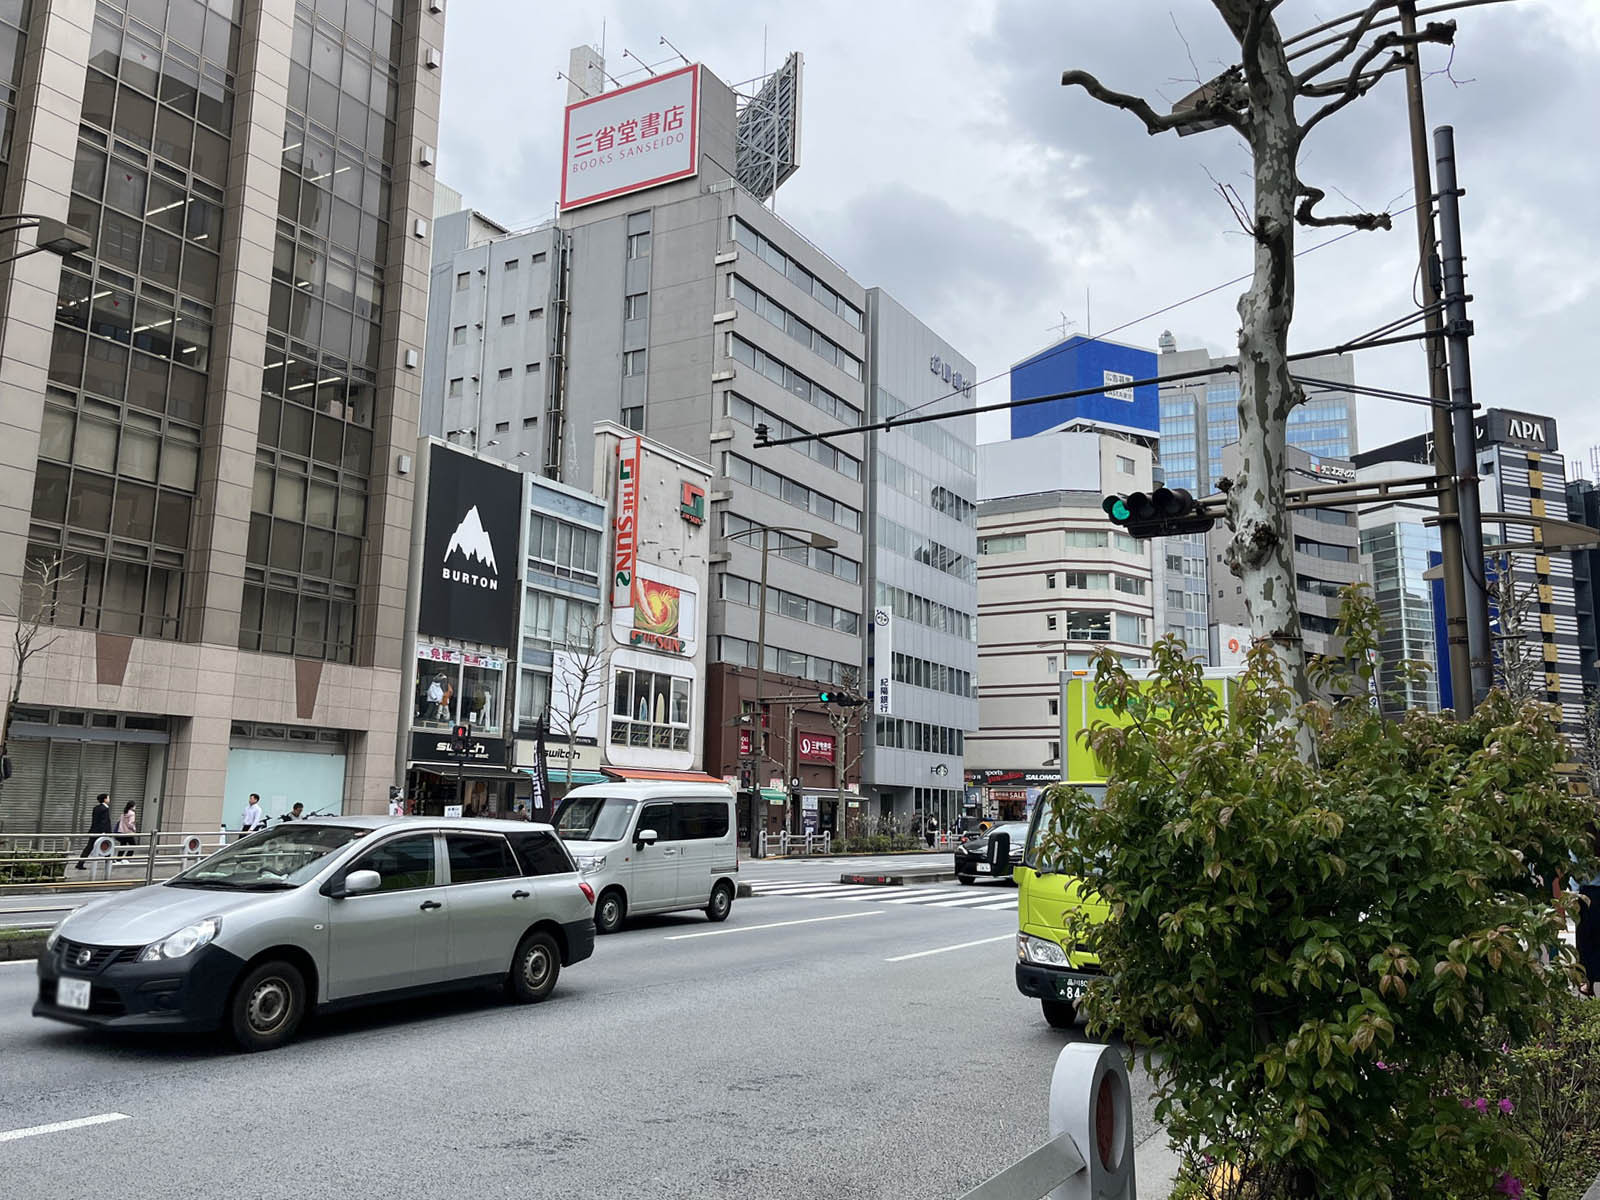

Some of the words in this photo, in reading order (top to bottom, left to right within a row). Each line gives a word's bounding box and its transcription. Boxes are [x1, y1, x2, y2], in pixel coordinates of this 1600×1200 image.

[574, 105, 685, 158] 三省堂書店
[572, 152, 614, 173] BOOKS
[620, 132, 684, 160] SANSEIDO
[1509, 419, 1545, 442] APA
[442, 567, 498, 591] BURTON
[1010, 791, 1025, 799] SALE
